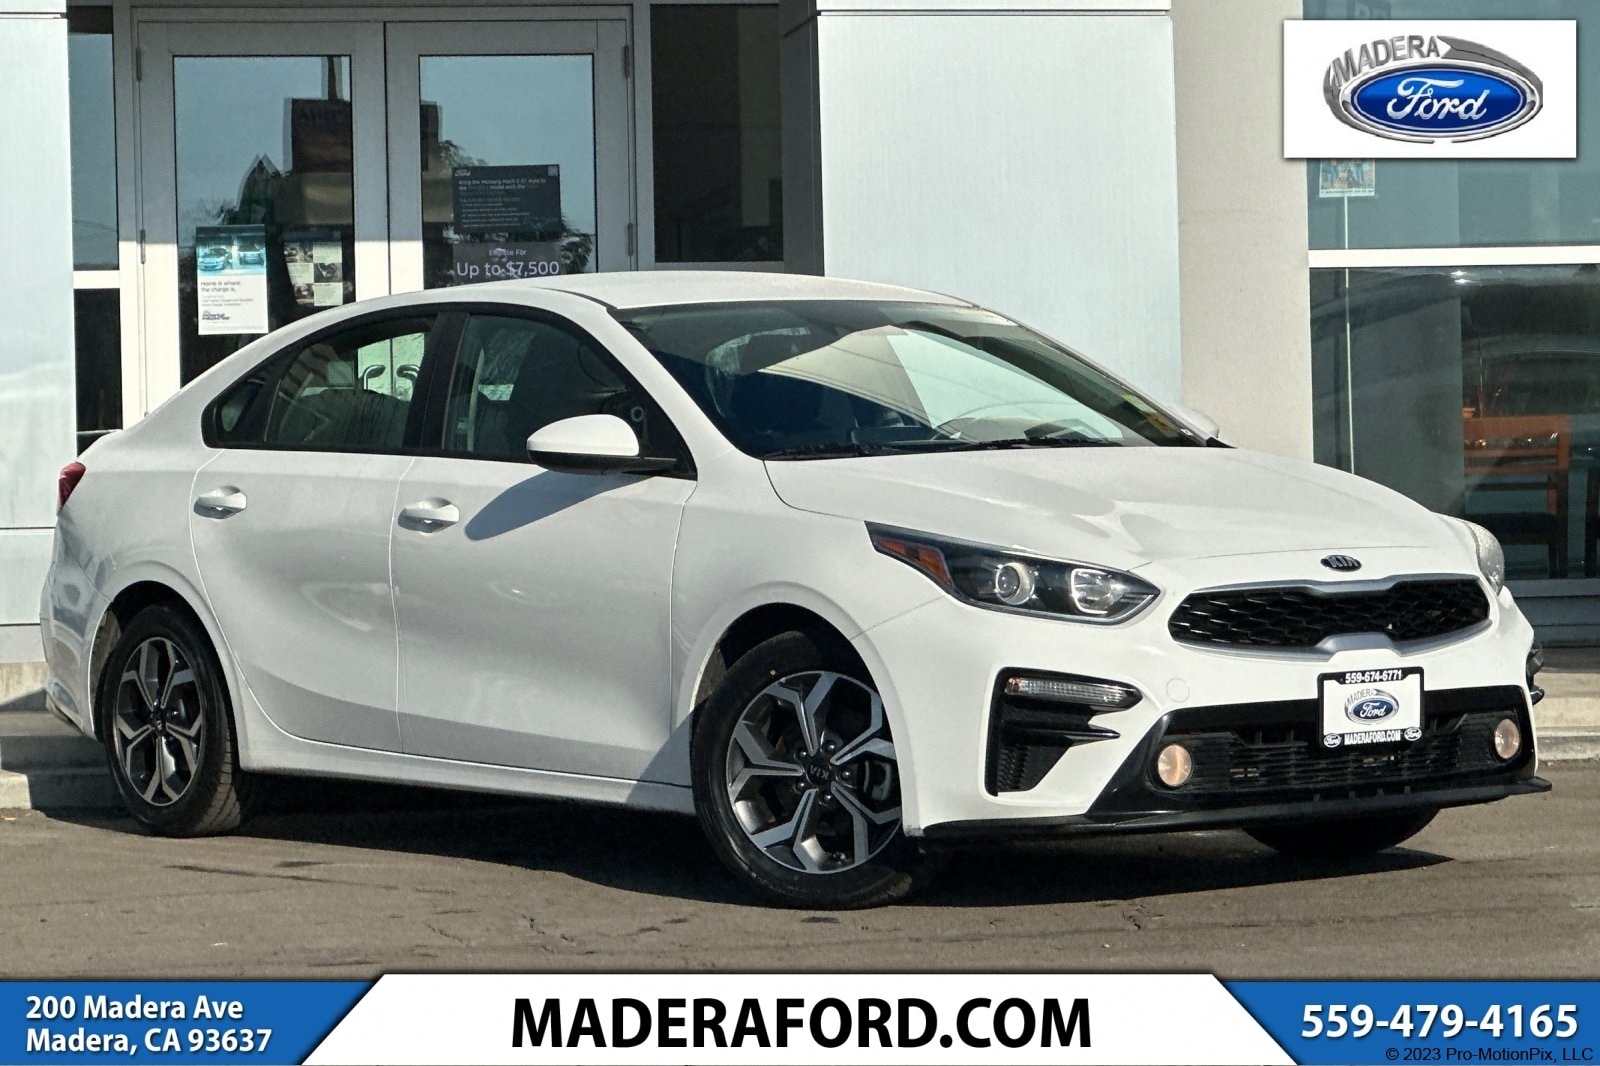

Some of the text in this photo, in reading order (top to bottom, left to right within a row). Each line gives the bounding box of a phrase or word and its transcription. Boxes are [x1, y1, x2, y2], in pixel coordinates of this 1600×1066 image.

[456, 261, 560, 279] Up to $7,500
[1345, 669, 1402, 684] 559-674-6771
[1346, 688, 1376, 706] MADERA
[1359, 702, 1387, 718] Ford
[1344, 730, 1401, 746] MADERAFORD.COM
